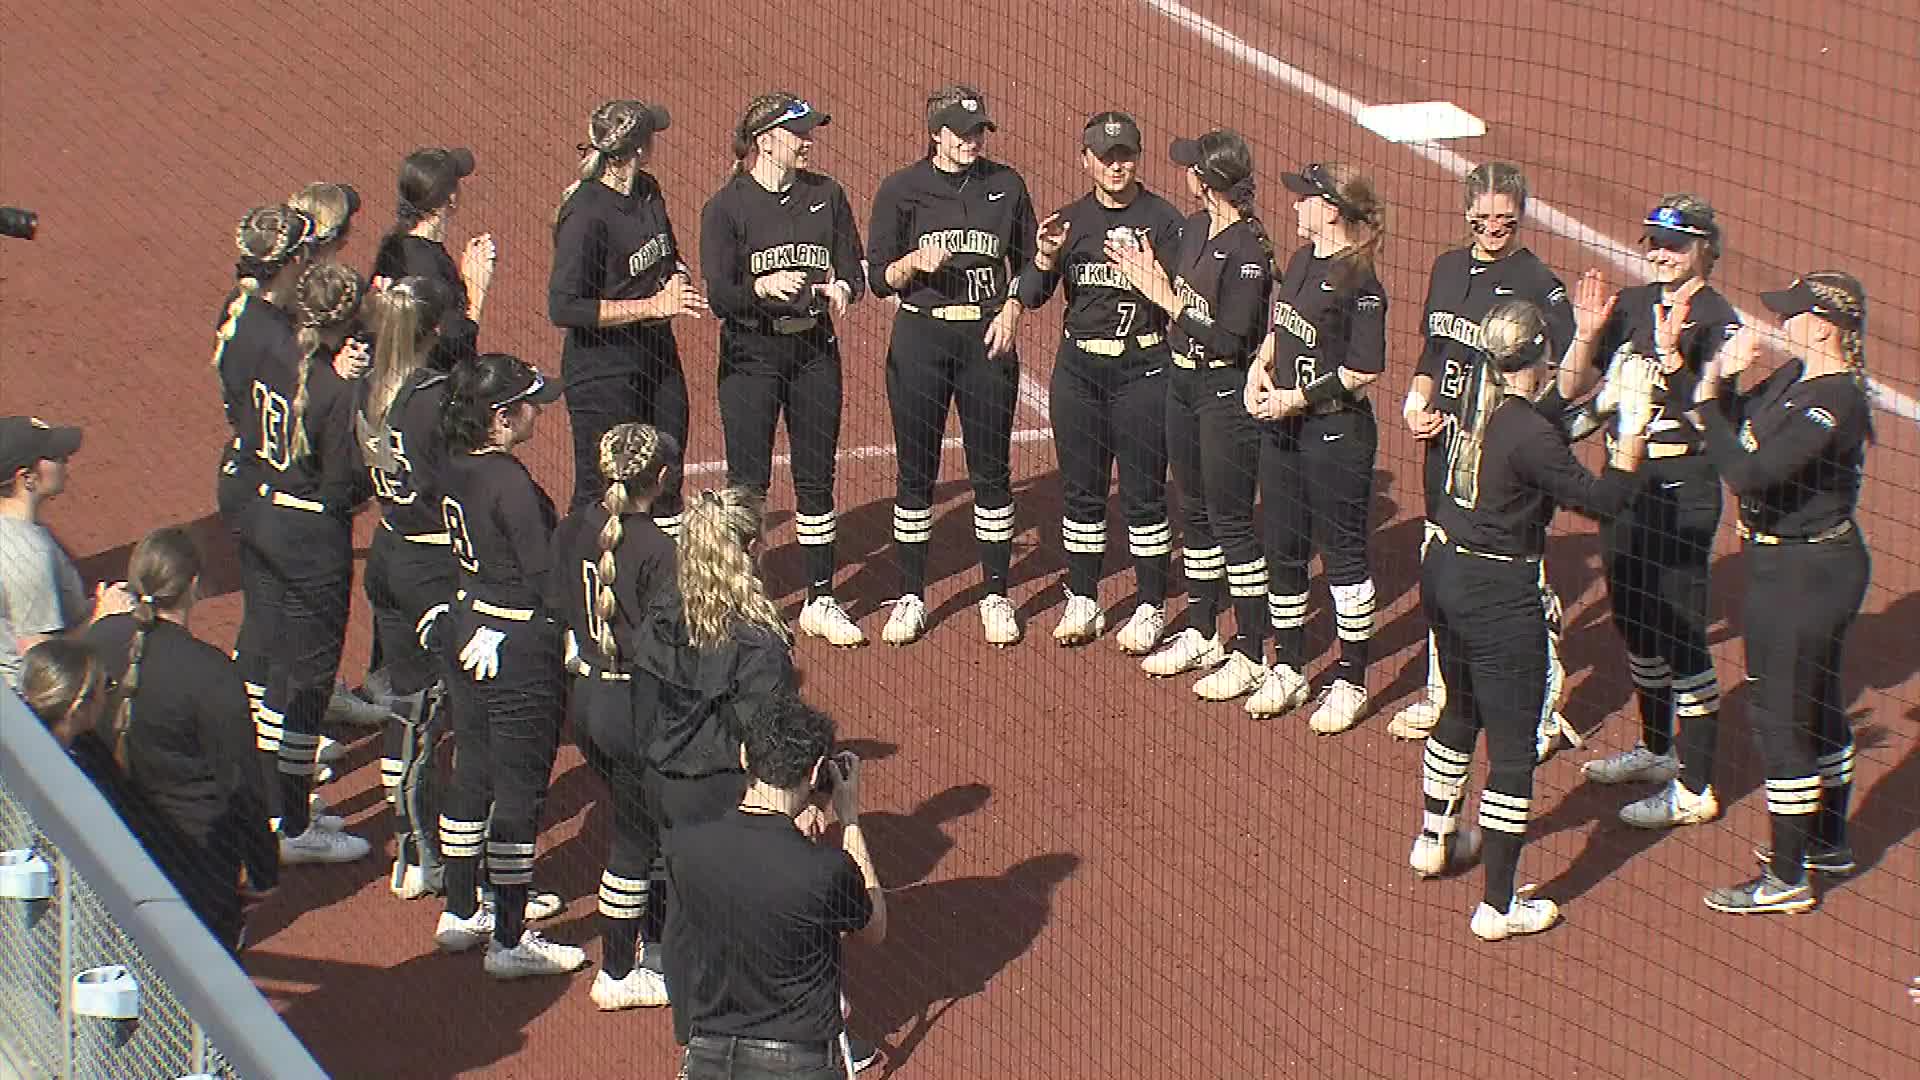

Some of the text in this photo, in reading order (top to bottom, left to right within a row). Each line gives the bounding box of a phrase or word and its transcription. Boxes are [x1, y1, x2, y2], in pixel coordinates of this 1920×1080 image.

[750, 243, 830, 275] OAKLAND
[965, 267, 998, 303] 14
[1114, 302, 1137, 338] 7
[252, 380, 291, 472] 13
